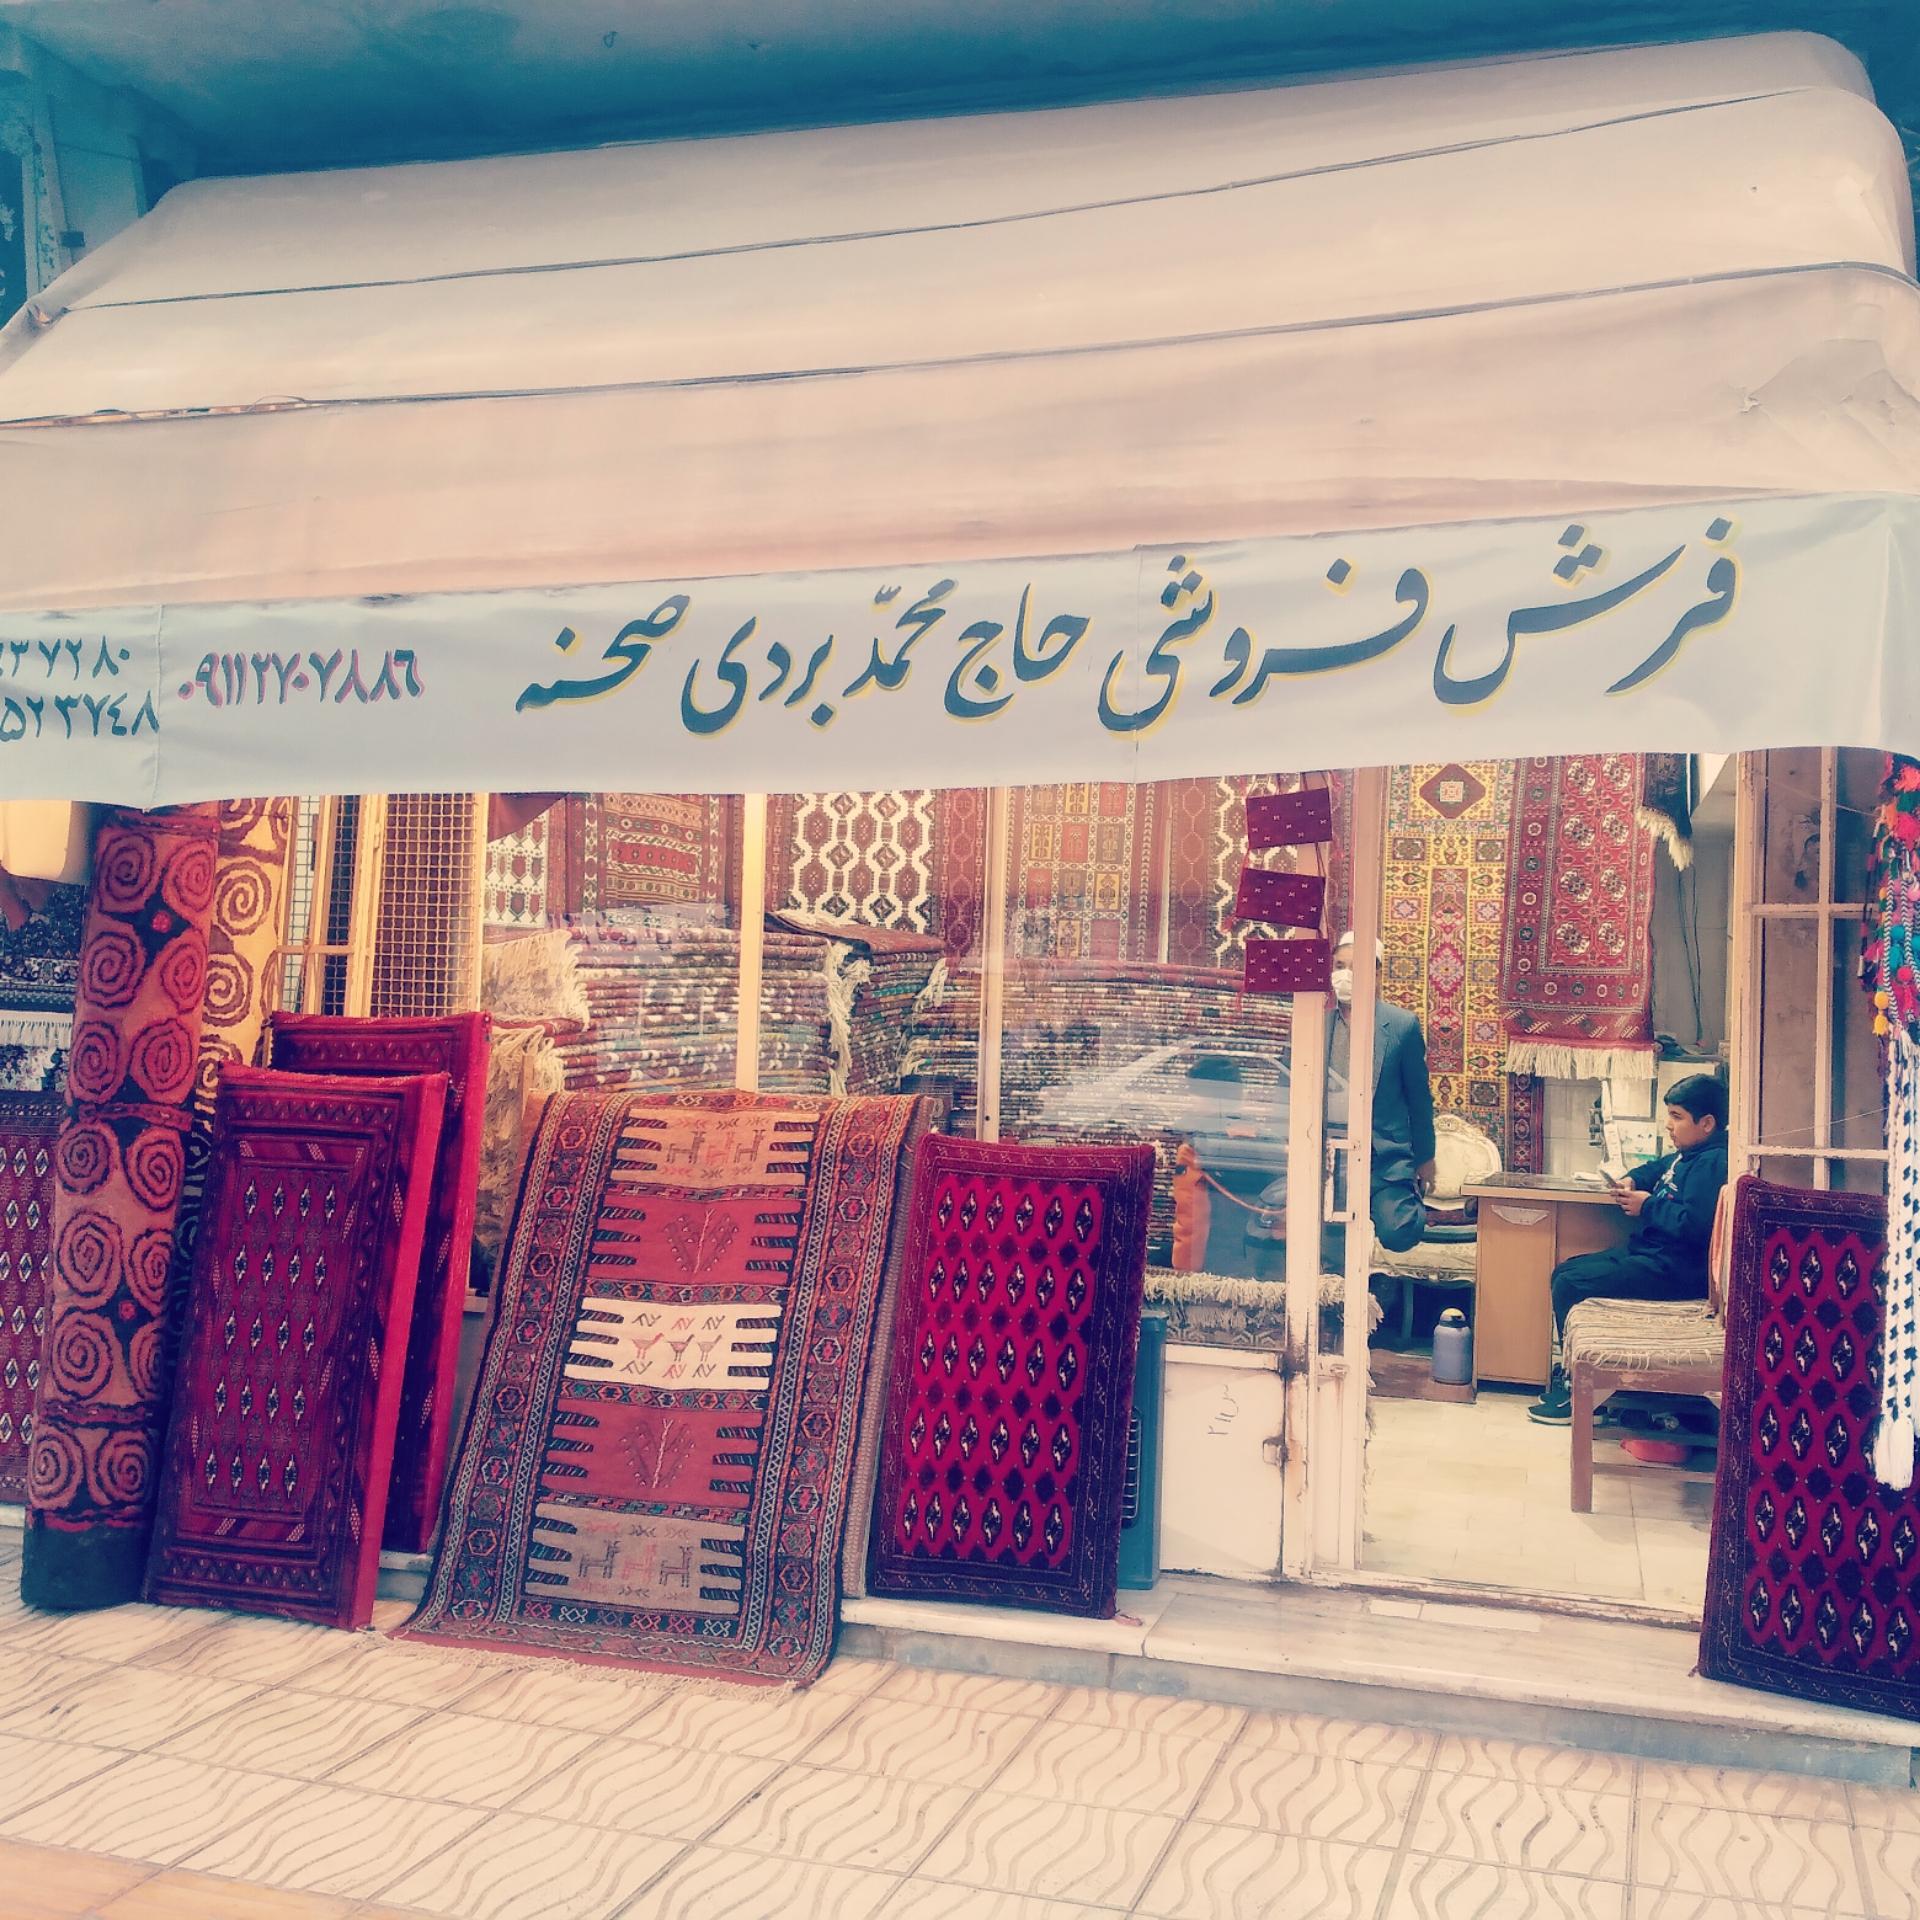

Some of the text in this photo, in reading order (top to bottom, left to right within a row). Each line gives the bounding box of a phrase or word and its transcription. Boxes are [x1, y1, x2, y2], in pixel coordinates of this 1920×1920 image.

[0, 635, 130, 681] ۳۷۲۸۰
[681, 616, 835, 735] بردی
[944, 582, 1091, 719] حاج
[1098, 555, 1431, 733] فروشی
[1434, 517, 1738, 706] فرش
